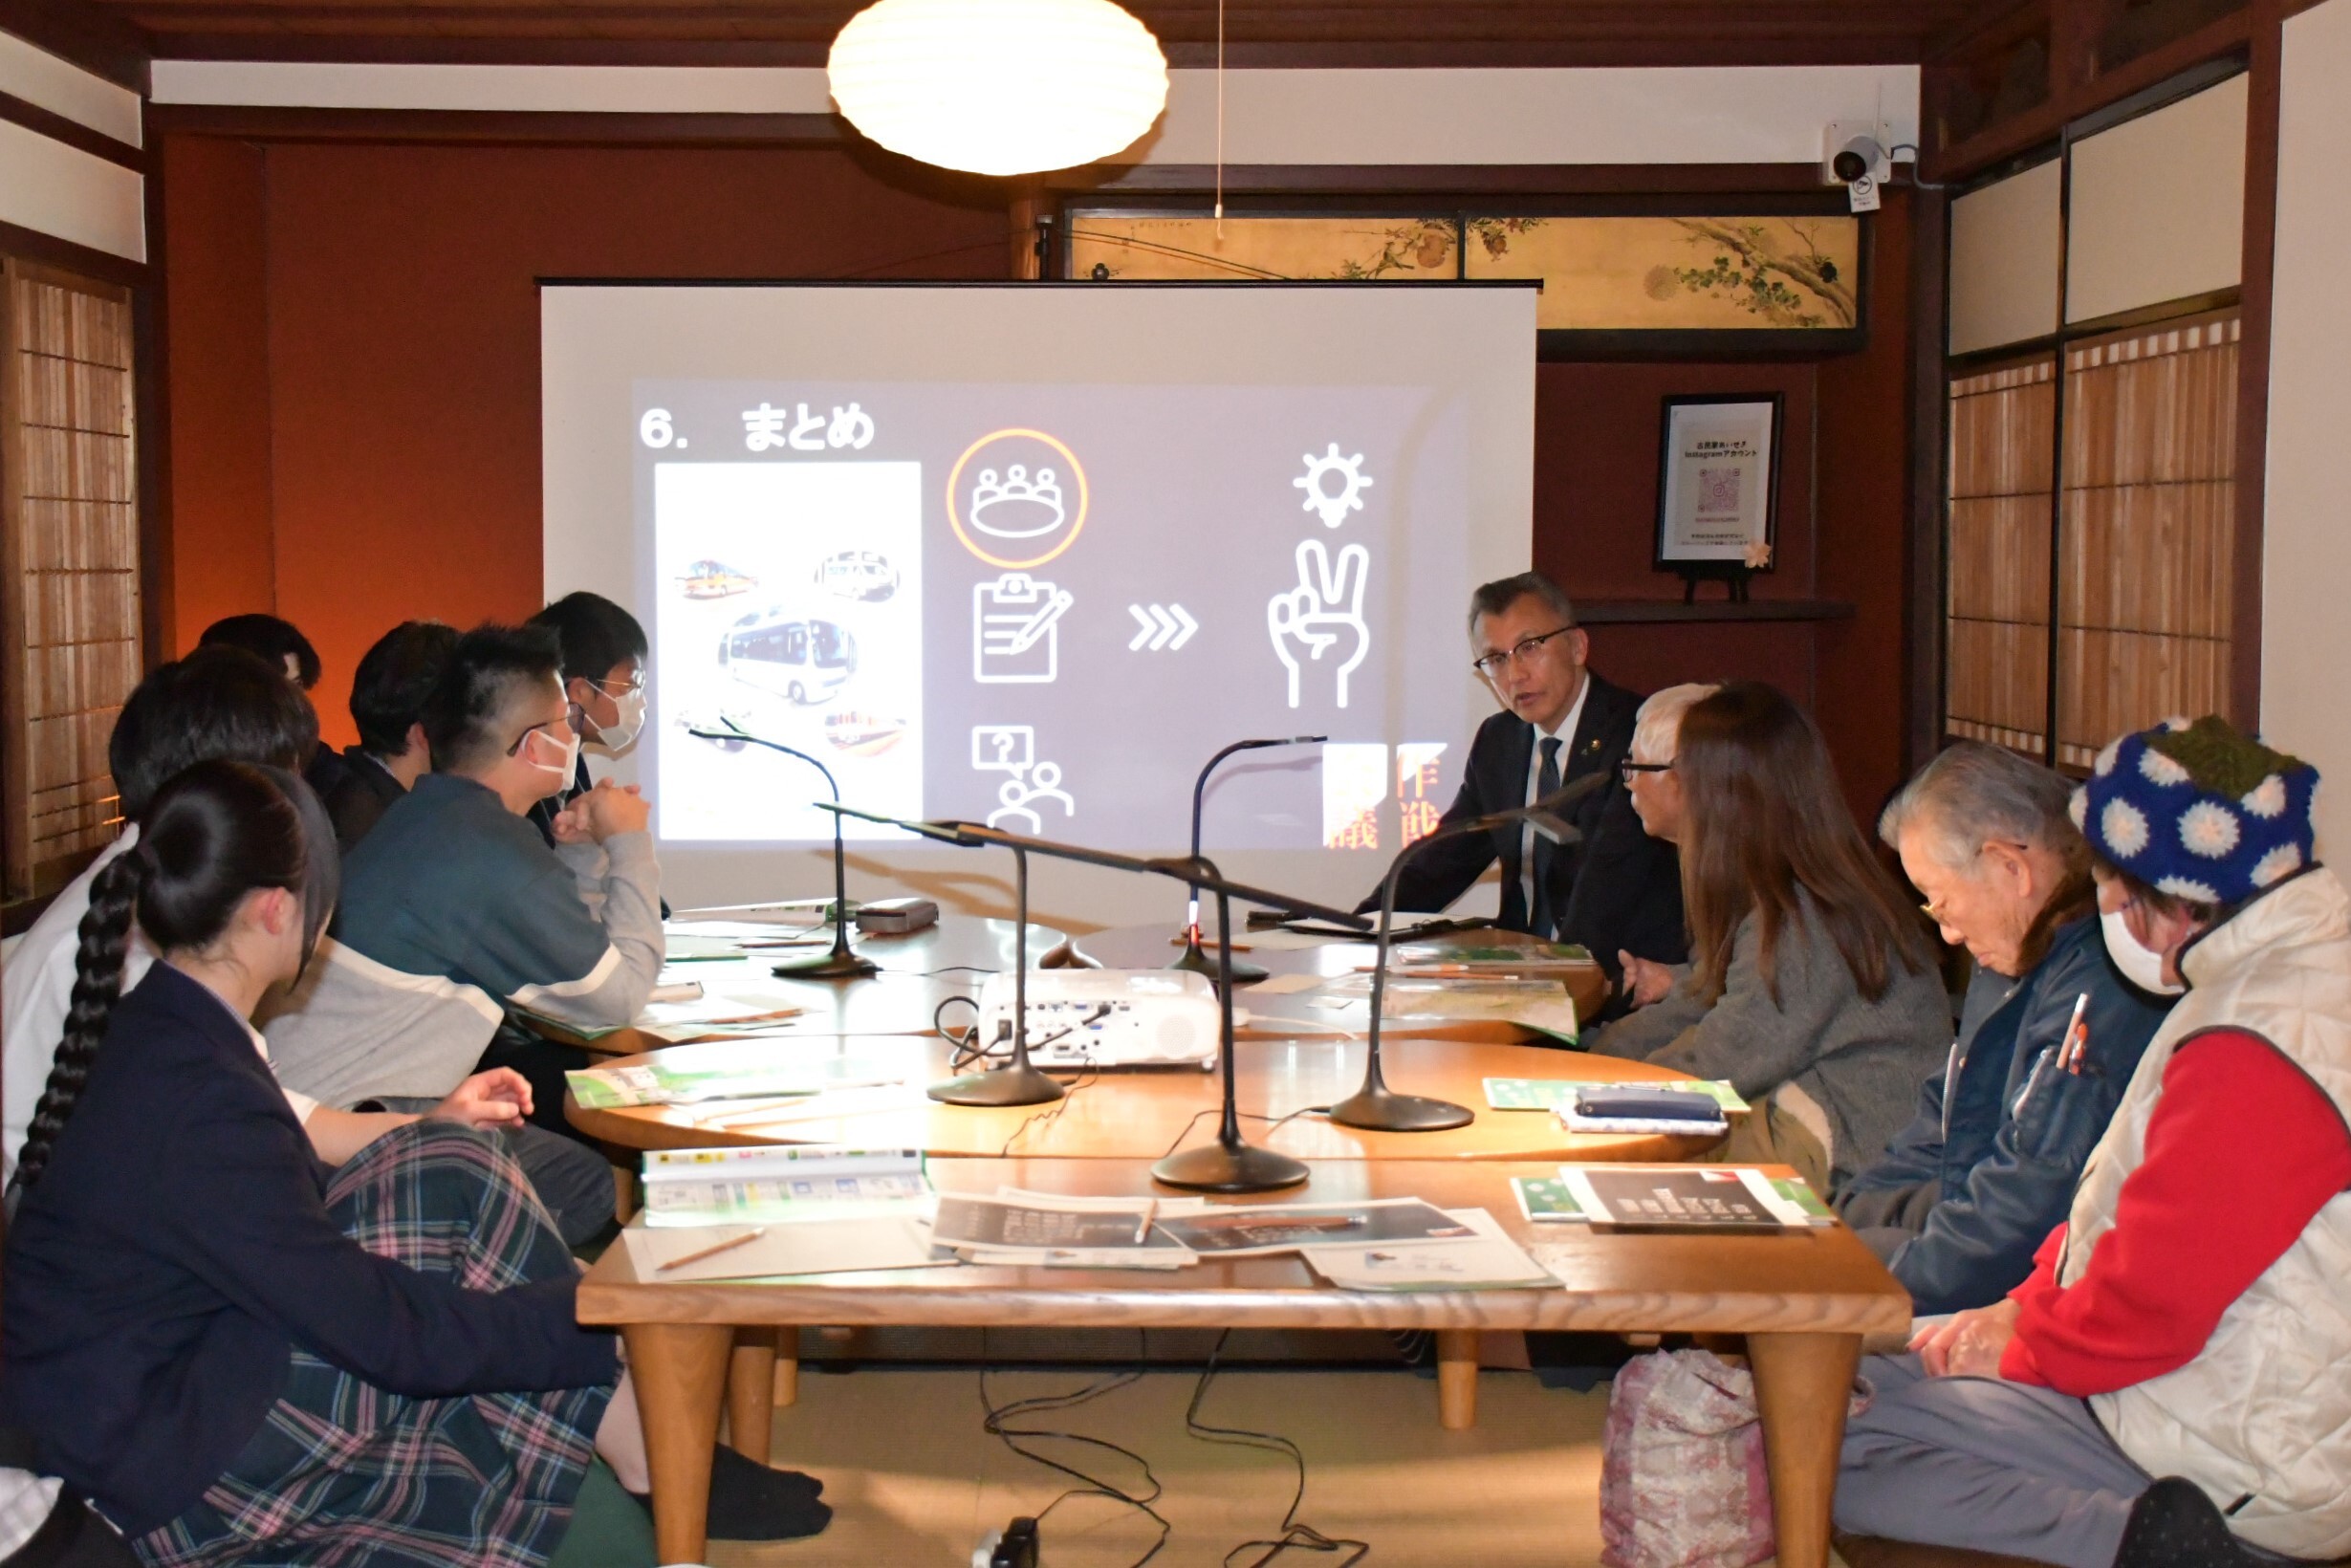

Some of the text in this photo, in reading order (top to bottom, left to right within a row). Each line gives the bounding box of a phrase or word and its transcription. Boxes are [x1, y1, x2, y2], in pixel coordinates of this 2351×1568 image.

[640, 402, 875, 451] 6. まとめ
